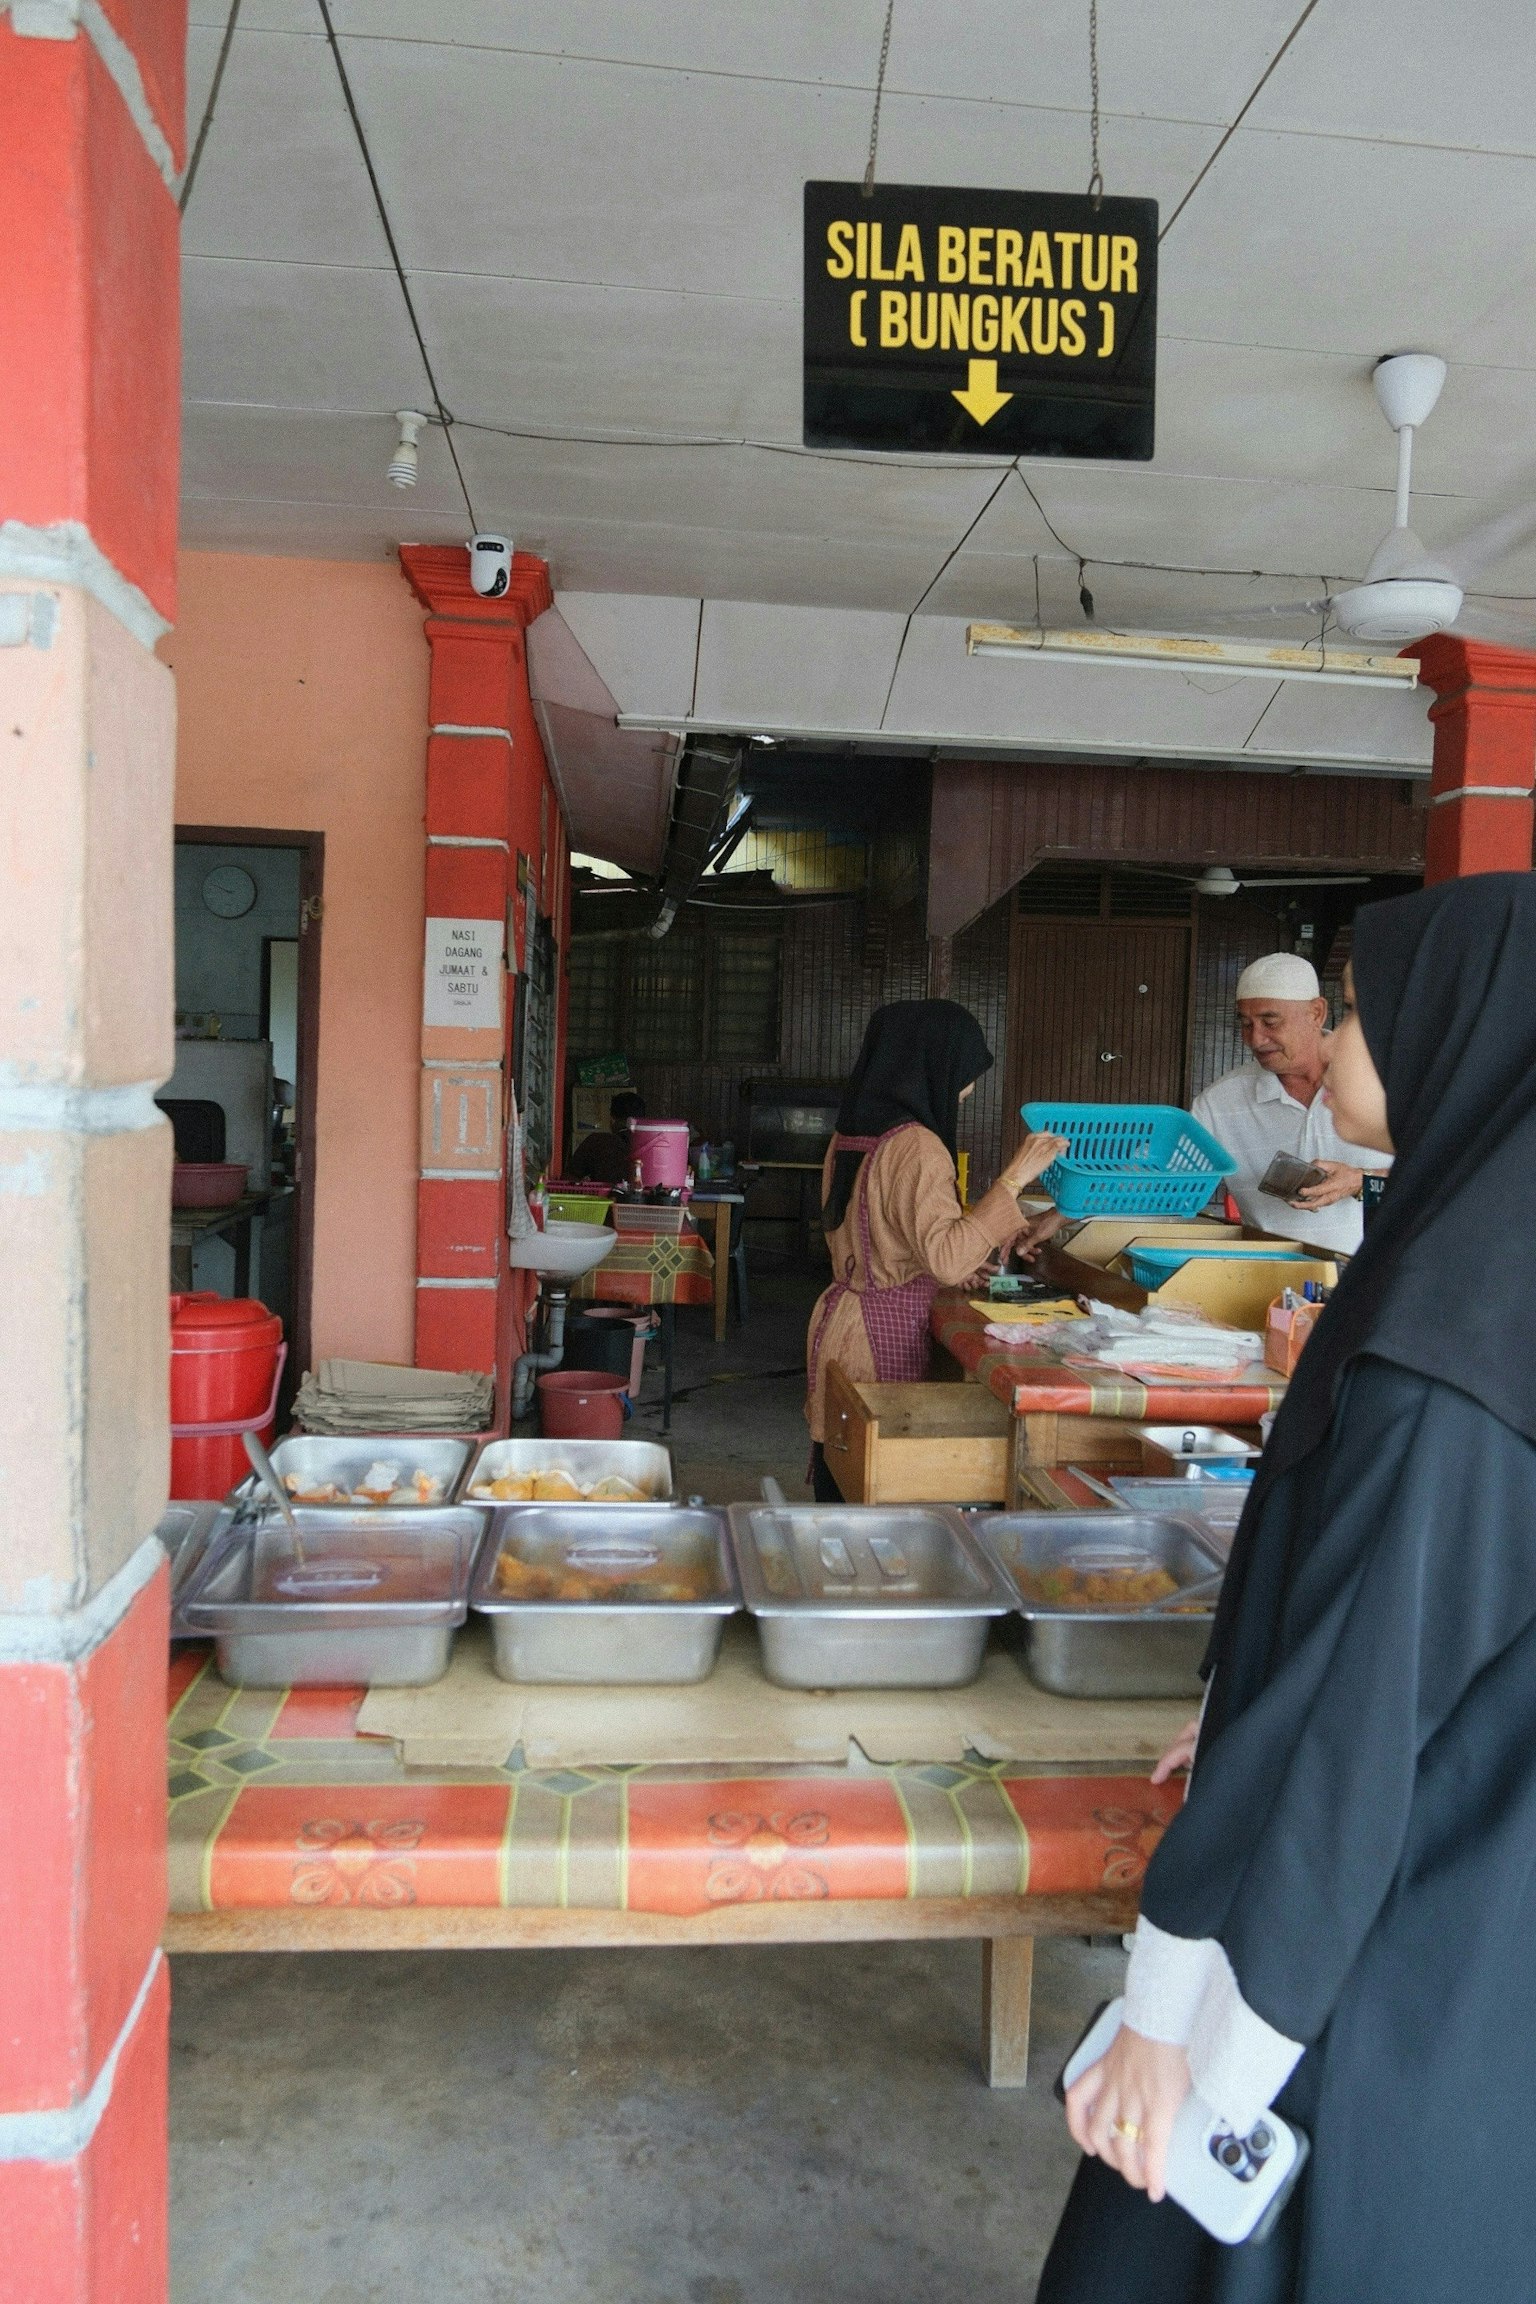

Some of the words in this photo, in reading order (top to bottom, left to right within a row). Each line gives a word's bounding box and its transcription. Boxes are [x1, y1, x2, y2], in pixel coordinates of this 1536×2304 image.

[826, 221, 925, 283] SILA
[938, 225, 1138, 294] BERATUR
[451, 930, 475, 941] NASI
[445, 947, 482, 958] DAGANG
[439, 965, 475, 976] JUMAAT
[481, 966, 488, 976] &
[447, 982, 478, 994] SABTU
